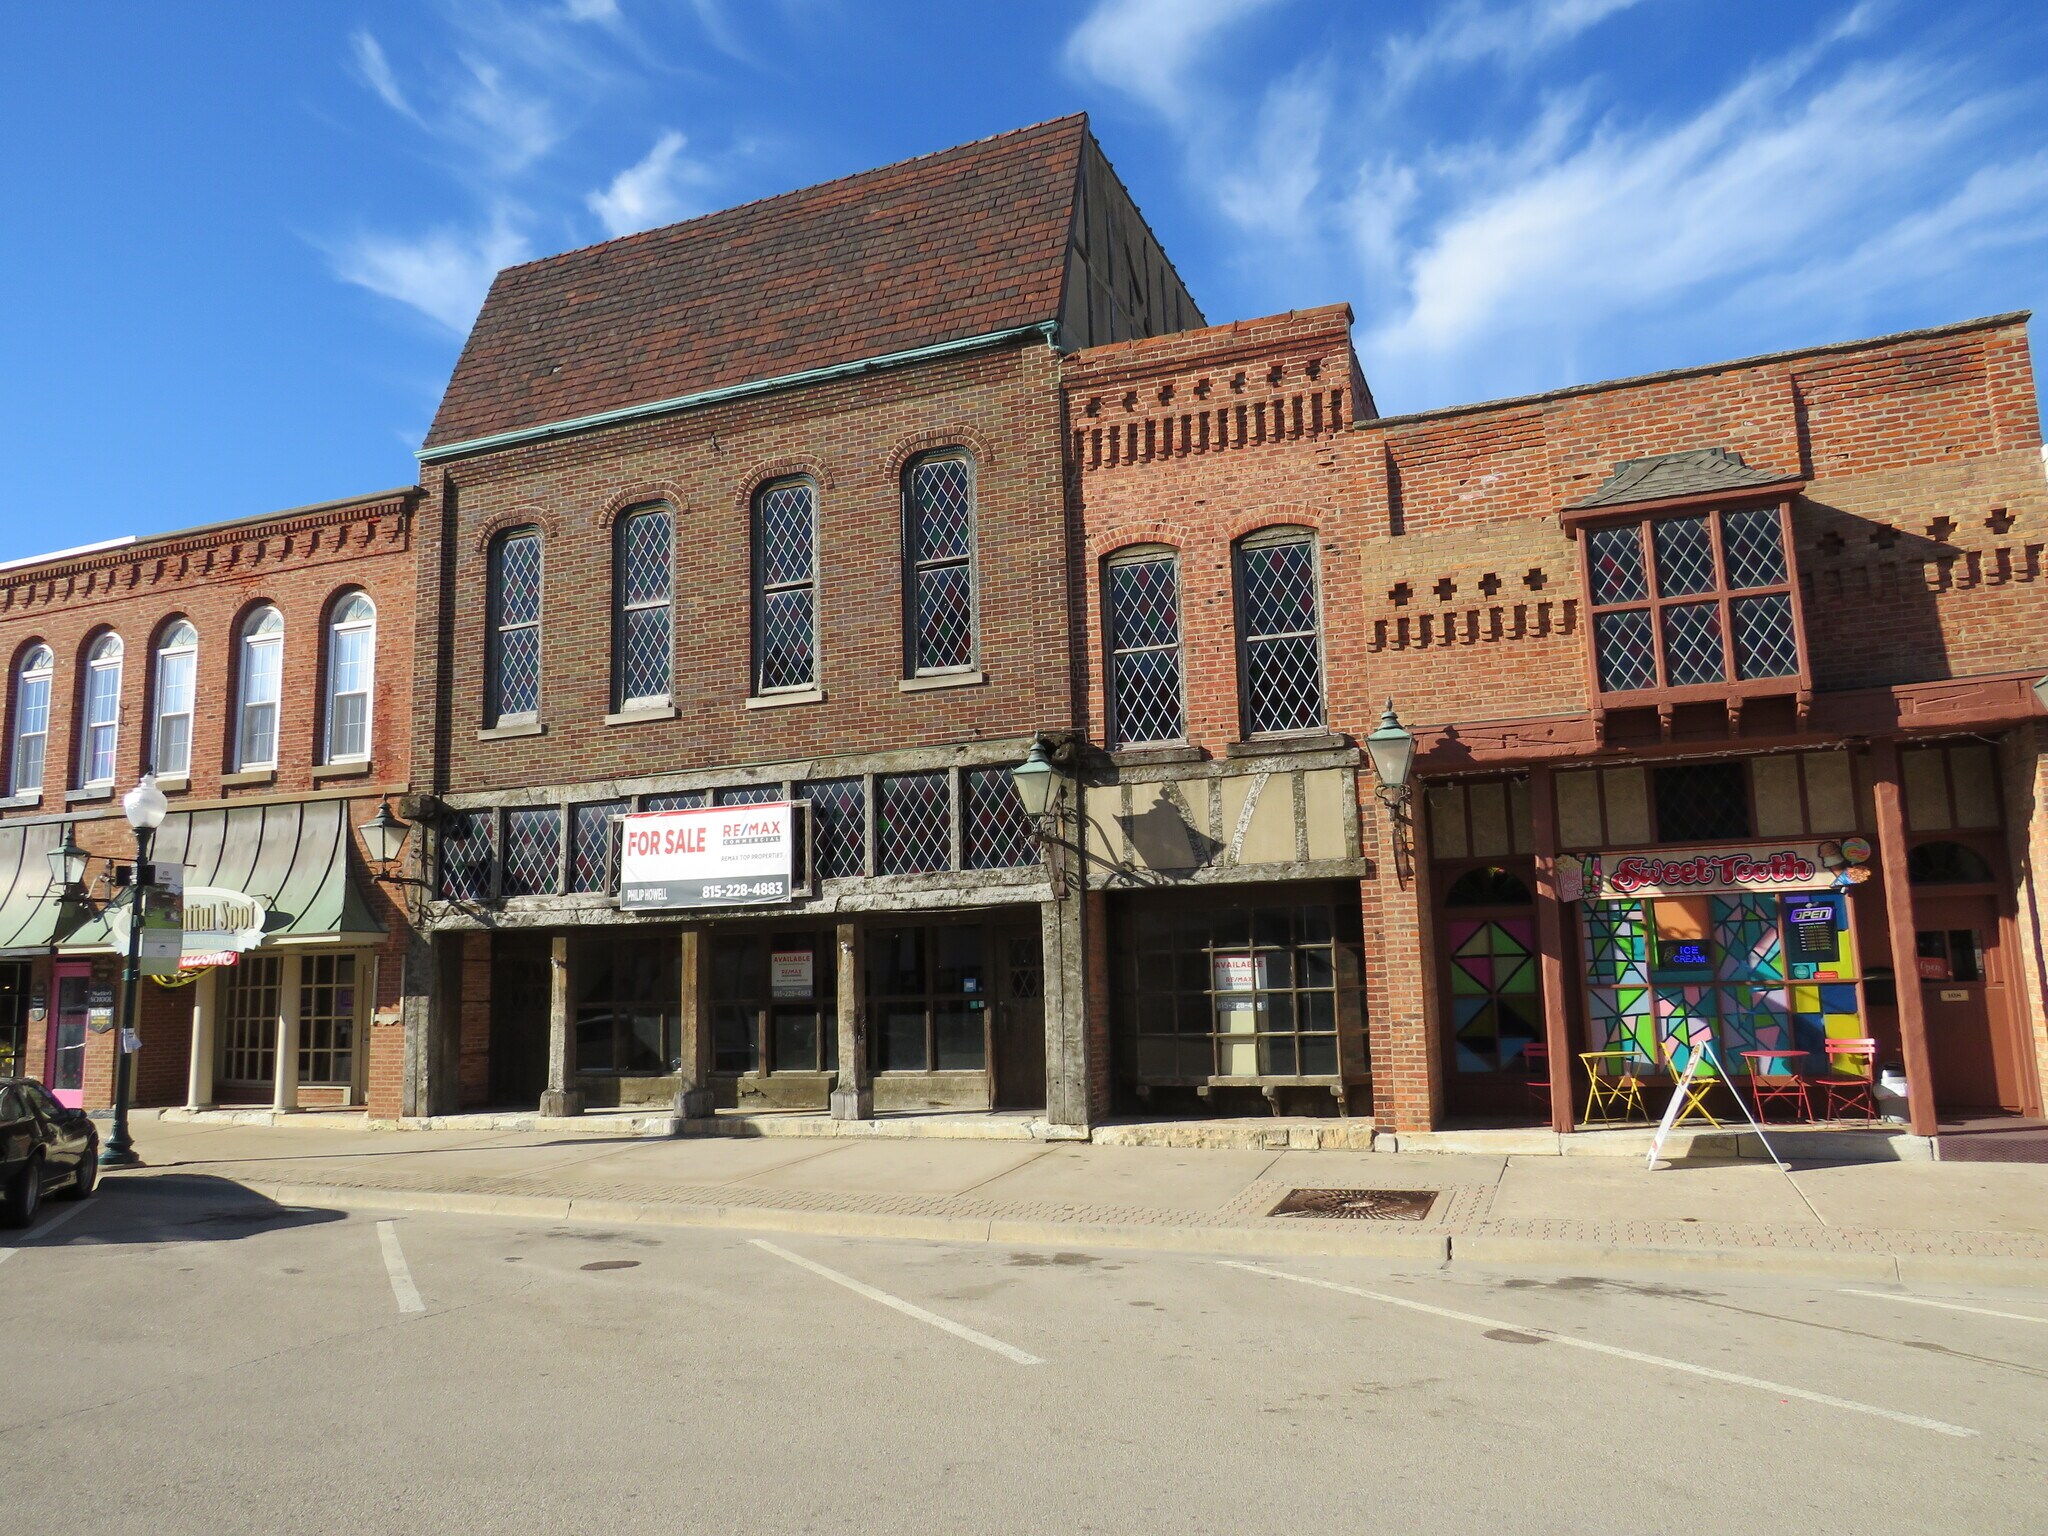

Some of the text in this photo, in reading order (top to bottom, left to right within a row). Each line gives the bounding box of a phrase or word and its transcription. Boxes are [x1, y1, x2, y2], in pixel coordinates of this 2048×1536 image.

[722, 821, 781, 838] RE/MAX
[628, 827, 706, 857] FOR SALE
[723, 837, 781, 845] COMMERCIAL
[751, 852, 784, 860] PROPERTIES
[1611, 851, 1815, 892] Sweet Tooth
[627, 887, 668, 902] PHILIP HOWELL
[702, 881, 783, 899] 815-228-4883
[220, 901, 256, 934] Spot
[1793, 909, 1829, 920] OPEN
[1679, 945, 1699, 954] ICE
[1673, 954, 1706, 963] CREAM
[1920, 960, 1942, 974] Open
